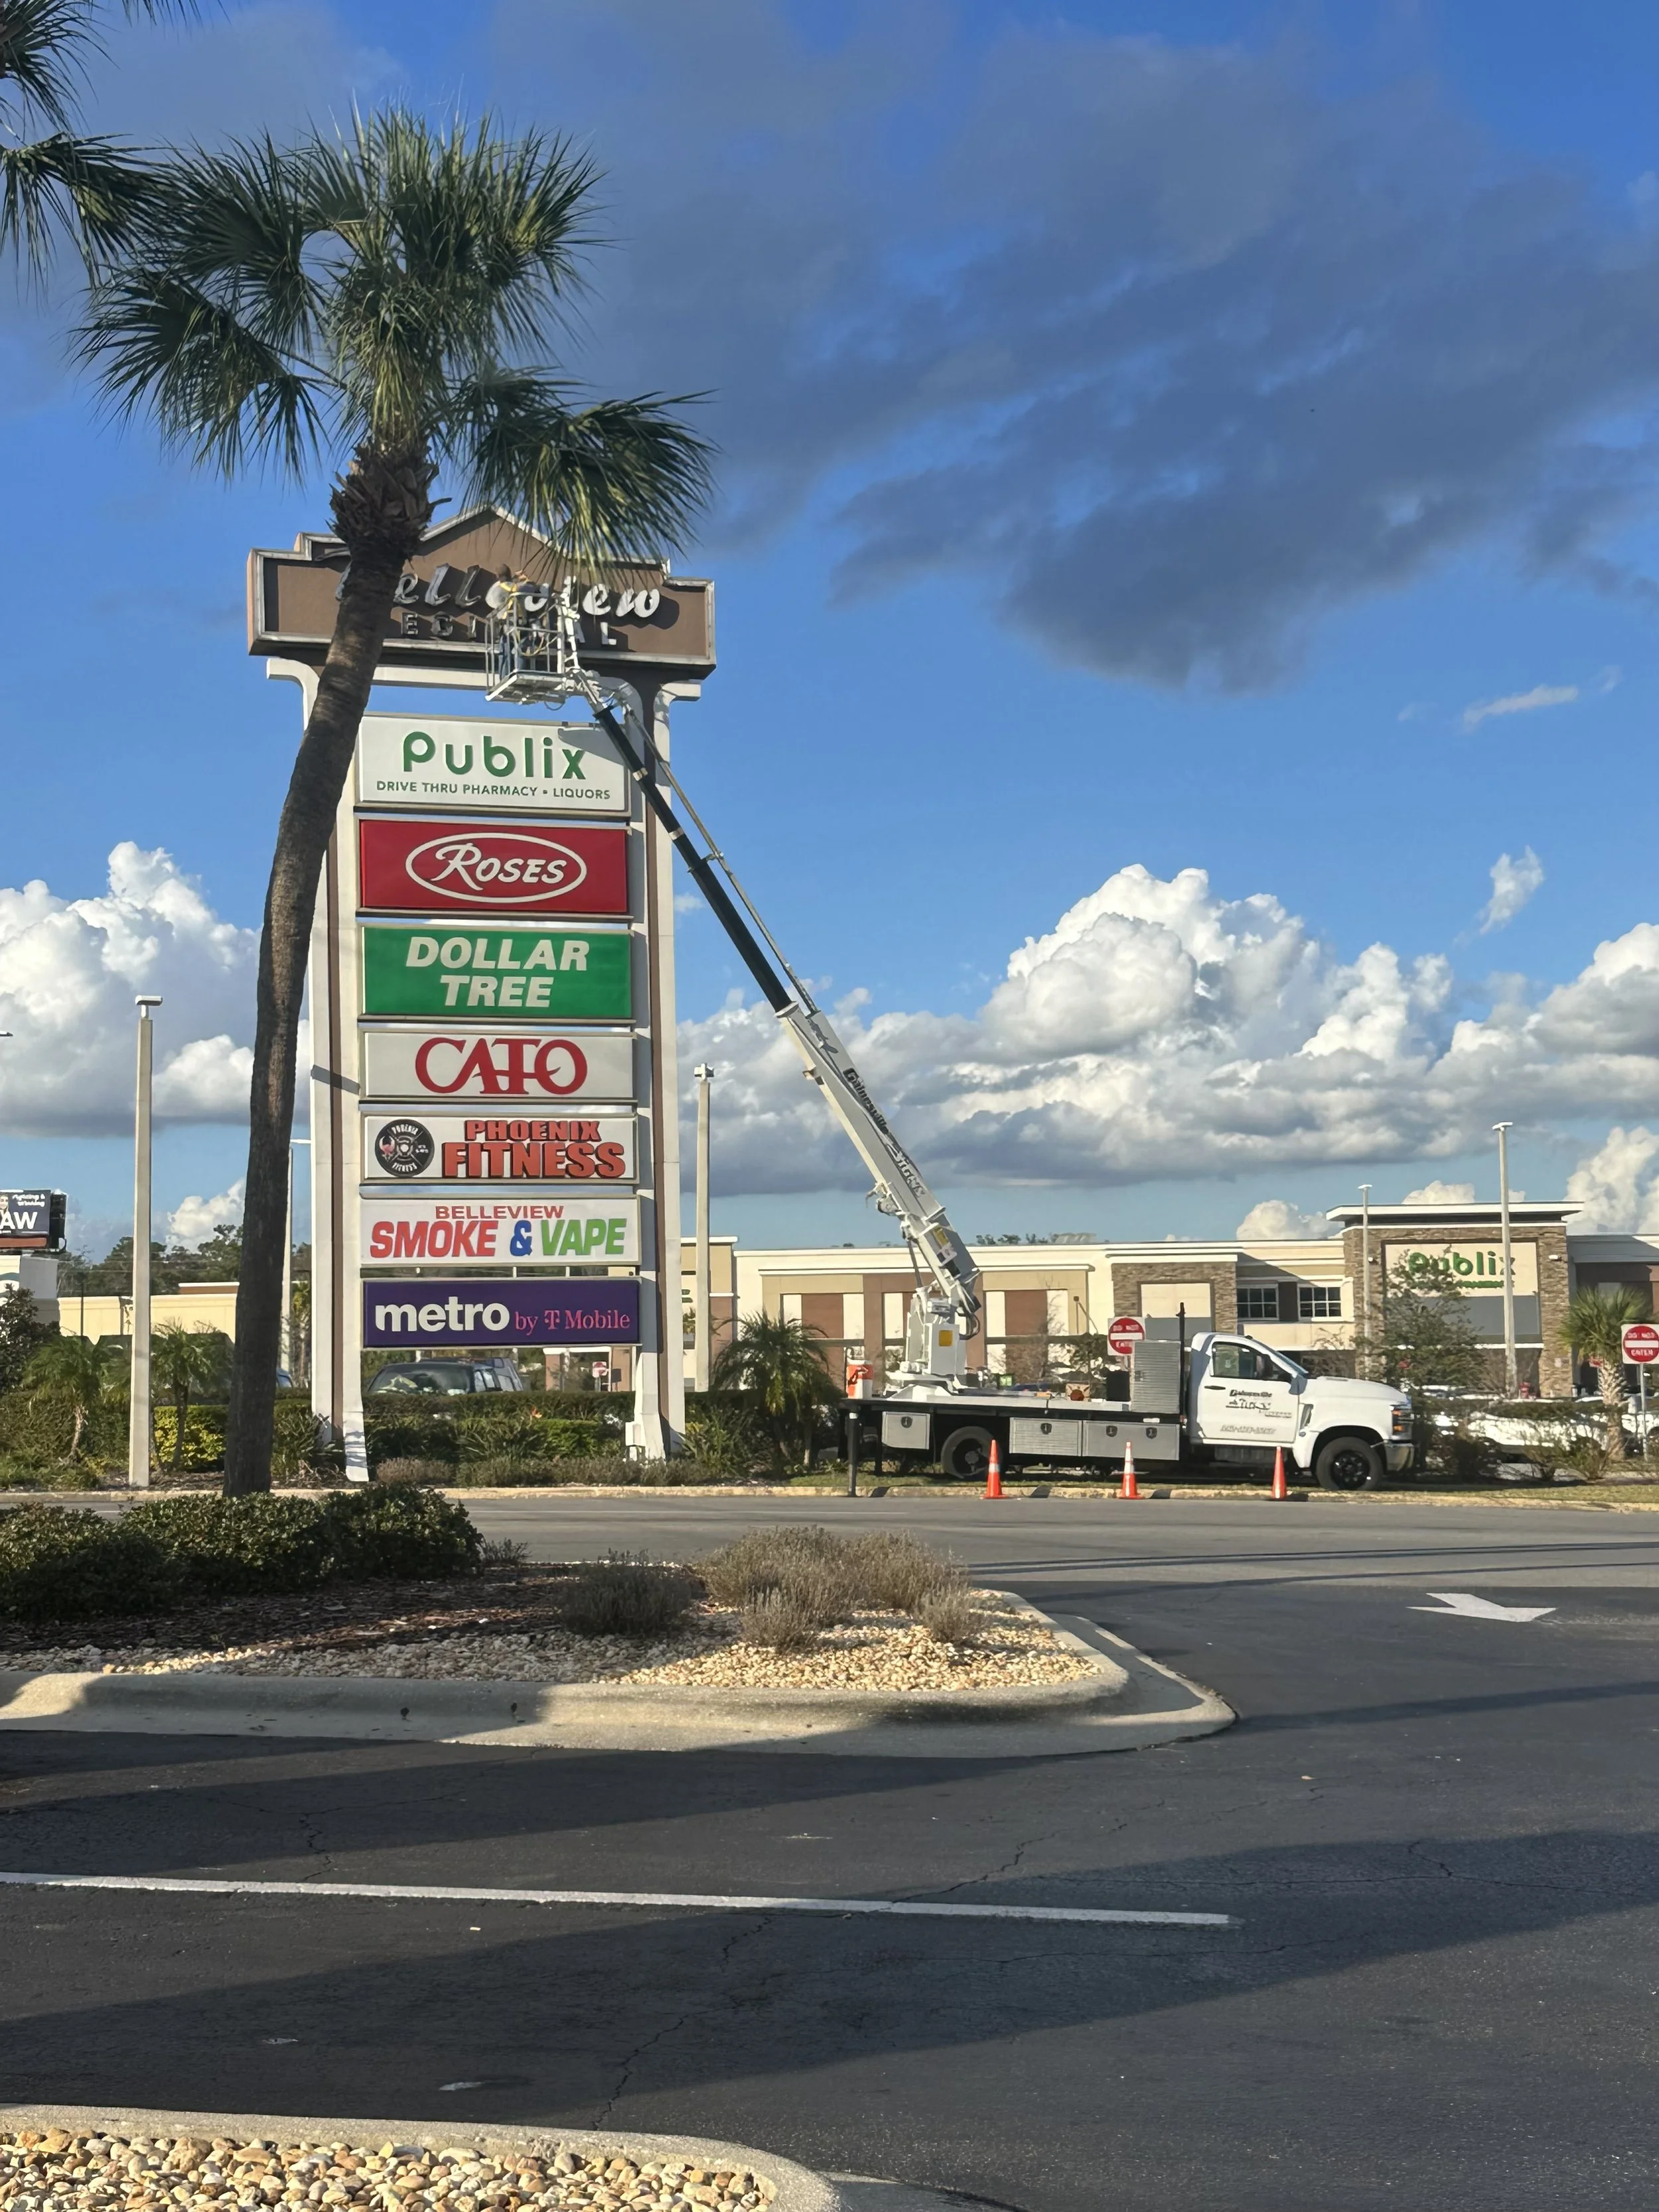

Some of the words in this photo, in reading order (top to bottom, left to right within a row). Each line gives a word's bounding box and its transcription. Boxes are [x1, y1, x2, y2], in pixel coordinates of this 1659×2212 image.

[403, 731, 587, 780] Publix
[376, 780, 417, 792] DRIVE
[422, 782, 458, 794] THRU
[464, 784, 538, 796] PHARMACY
[553, 788, 611, 800] LIQUORS
[405, 936, 589, 971] DOLLAR
[440, 975, 554, 1007] TREE
[415, 1037, 588, 1095] CATO
[464, 1120, 602, 1142] PHOENIX
[441, 1142, 626, 1179] FITNESS
[435, 1205, 565, 1220] BELLEVIEW
[370, 1220, 499, 1258] SMOKE
[510, 1219, 533, 1257] &
[541, 1218, 627, 1256] VAPE
[374, 1295, 510, 1332] metro
[514, 1311, 538, 1336] by
